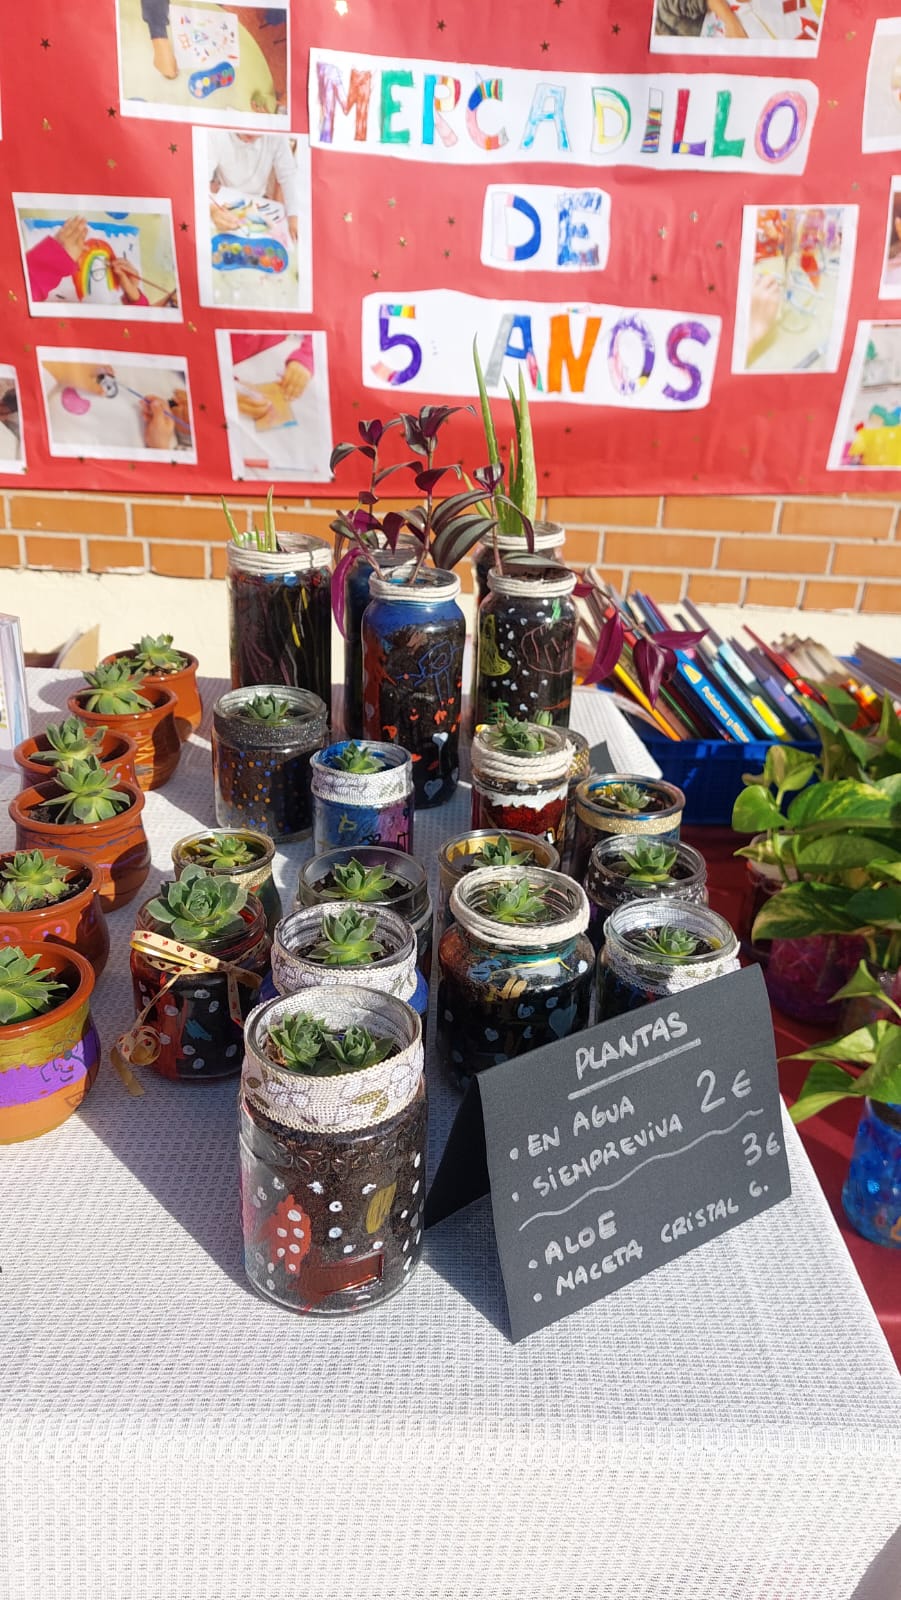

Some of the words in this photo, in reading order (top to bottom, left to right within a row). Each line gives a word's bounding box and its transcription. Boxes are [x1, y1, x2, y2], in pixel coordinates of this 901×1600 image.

[316, 61, 808, 164] MERCADILLO
[490, 191, 603, 267] DE
[371, 304, 422, 386] 5
[485, 306, 711, 402] AÑOS
[575, 1011, 688, 1080] PLANTAS
[528, 1126, 560, 1157] EN
[573, 1095, 635, 1137] AGUA
[544, 1210, 618, 1265] ALOE
[556, 1239, 643, 1296] MACETA
